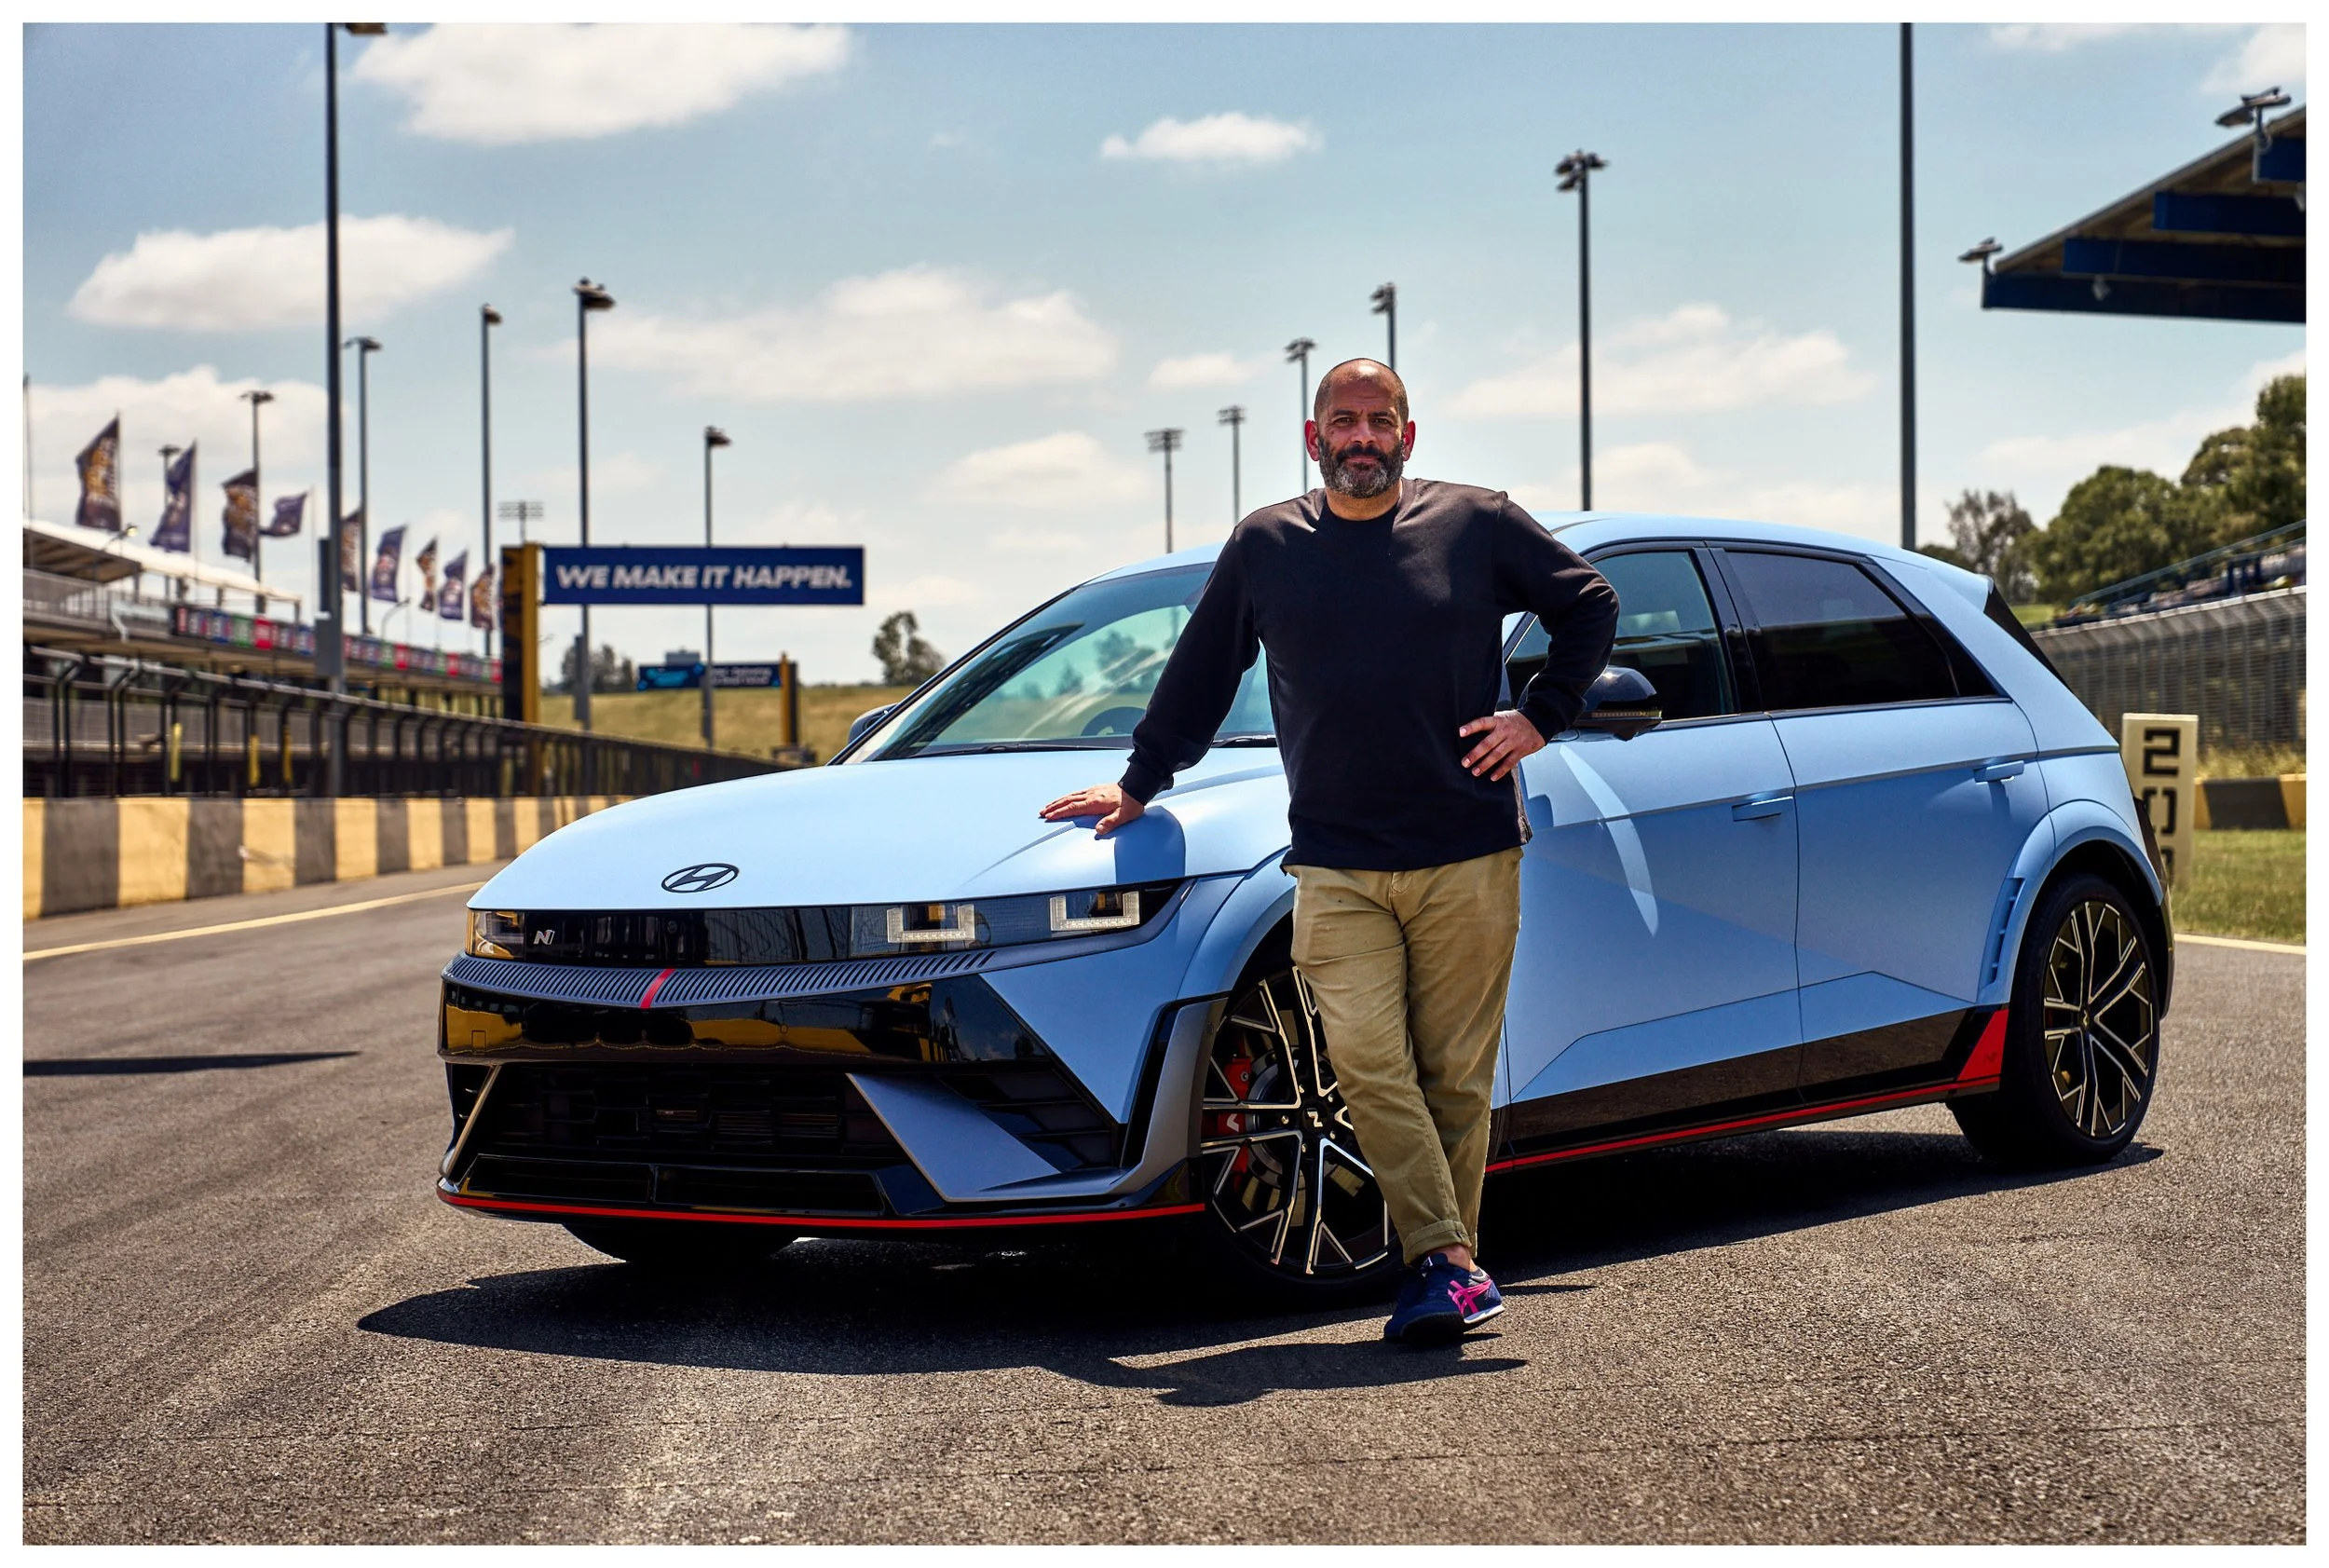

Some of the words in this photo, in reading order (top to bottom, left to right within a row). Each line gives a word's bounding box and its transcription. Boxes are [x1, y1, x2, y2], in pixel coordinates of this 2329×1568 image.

[557, 565, 608, 589] WE
[612, 565, 698, 589] MAKE
[701, 565, 729, 589] IT
[732, 565, 852, 589] HAPPEN.
[533, 929, 555, 946] N
